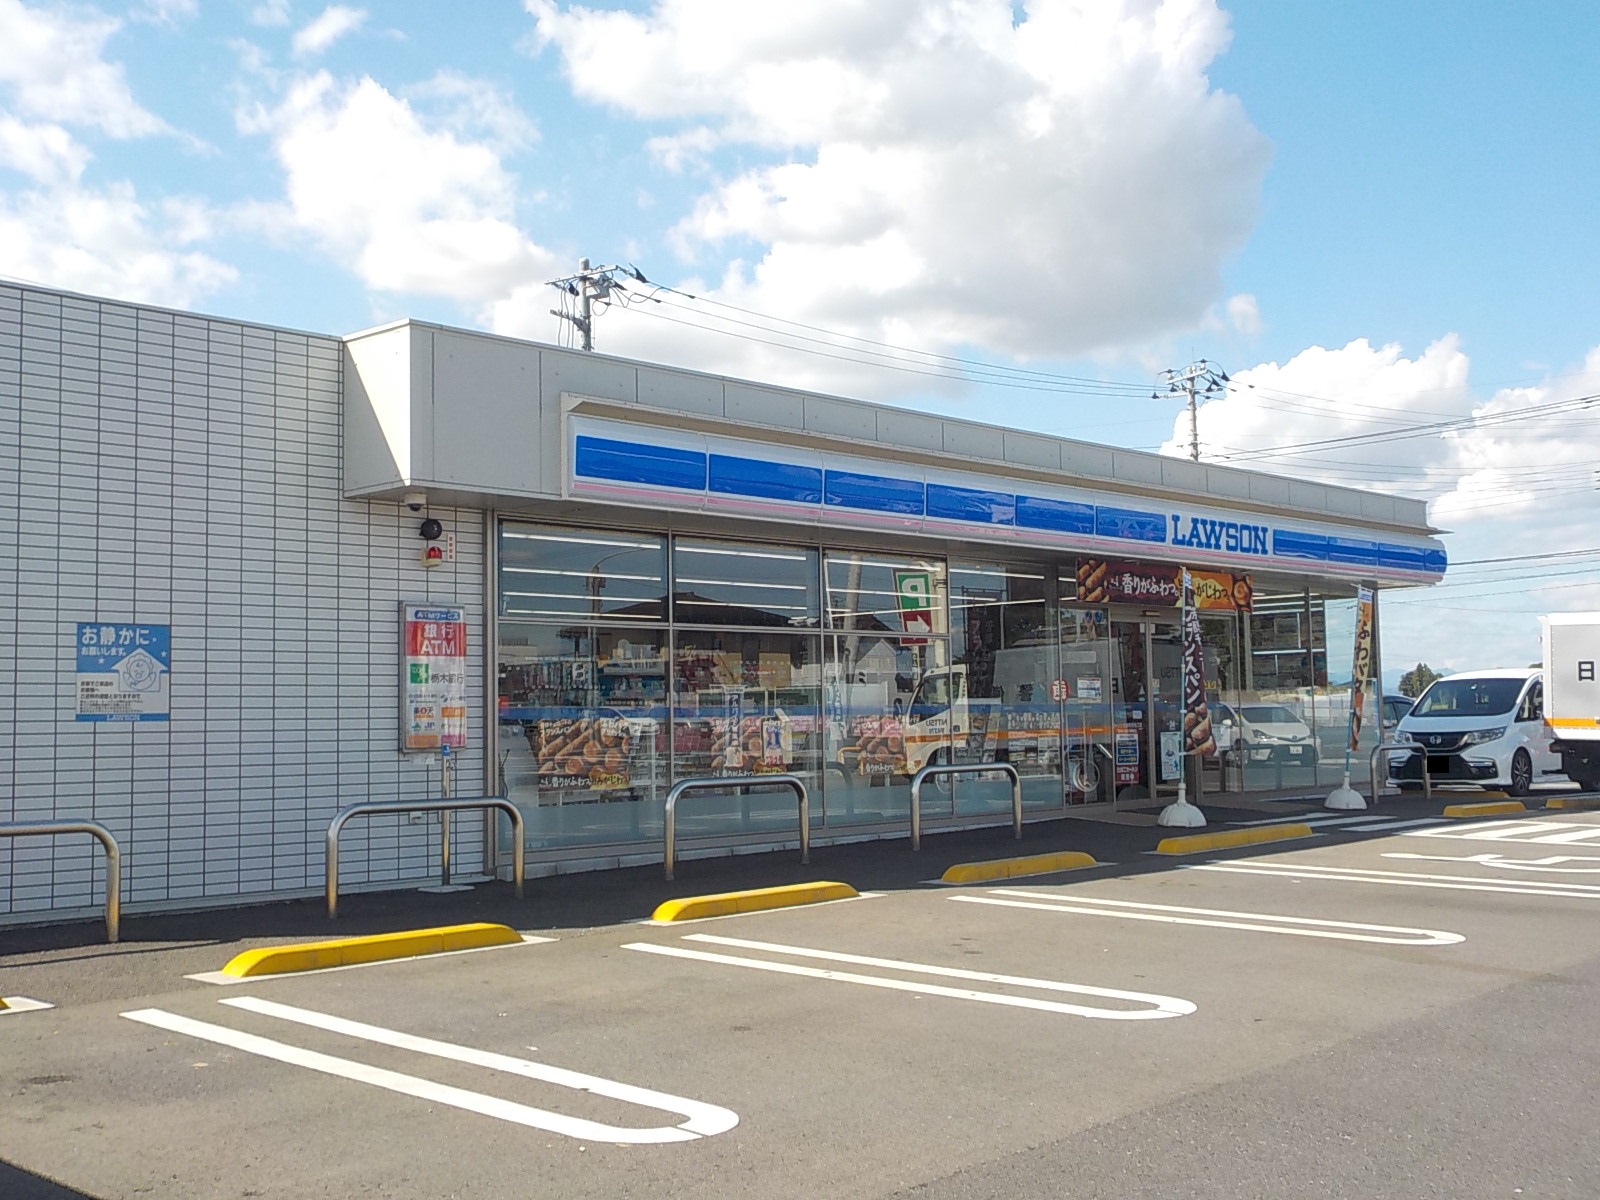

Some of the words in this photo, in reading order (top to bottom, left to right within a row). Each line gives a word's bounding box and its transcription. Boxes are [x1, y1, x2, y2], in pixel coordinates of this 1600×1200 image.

[1171, 514, 1268, 555] LAWSON
[81, 625, 150, 645] お静かに
[423, 623, 455, 639] 銀行
[80, 646, 127, 656] お願いします。
[420, 640, 455, 655] ATM
[1184, 606, 1201, 704] フランスパン
[1578, 661, 1595, 682] 日
